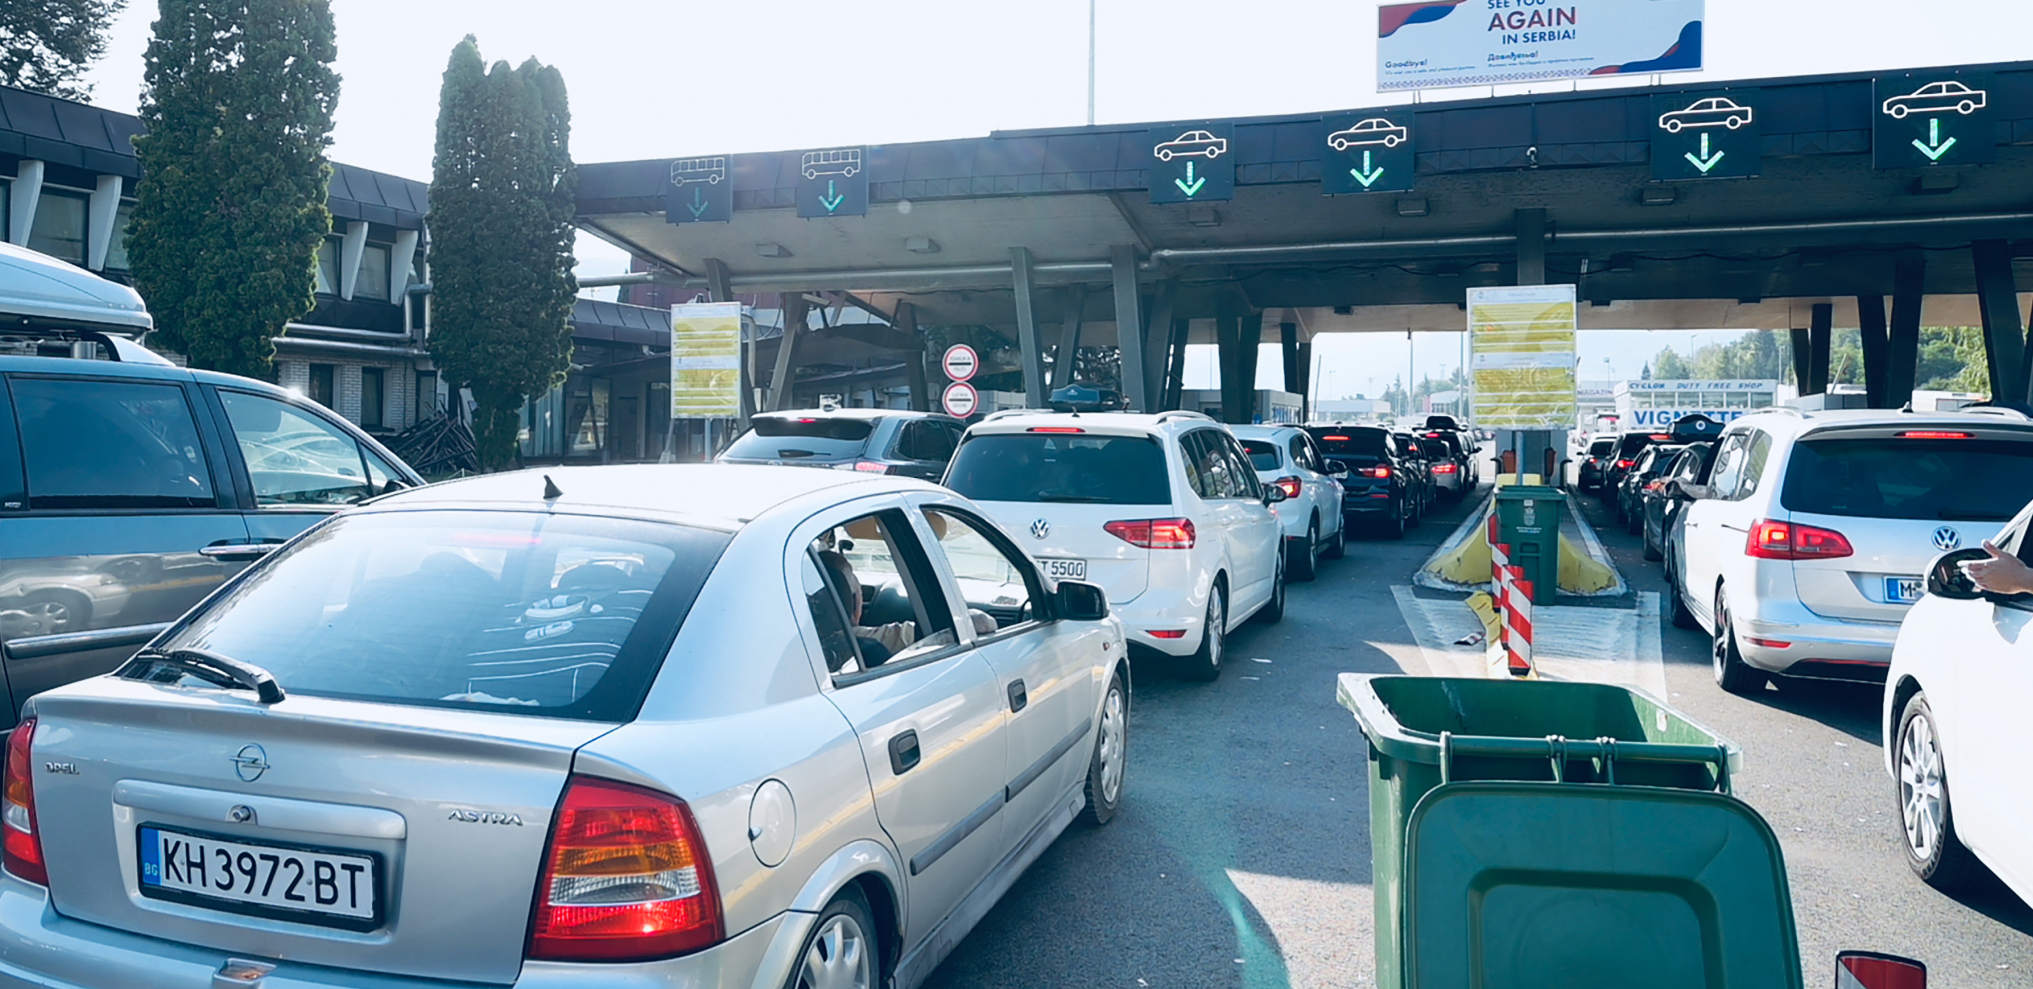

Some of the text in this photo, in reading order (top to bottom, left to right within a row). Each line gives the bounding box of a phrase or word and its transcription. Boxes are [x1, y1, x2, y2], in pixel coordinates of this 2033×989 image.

[1487, 0, 1510, 9] SEE
[1487, 6, 1576, 32] AGAIN
[1502, 29, 1576, 45] IN SERBIA!
[1385, 59, 1428, 68] Goodbye!
[1634, 410, 1743, 425] VIGNTTE
[1051, 560, 1083, 577] 5500
[45, 762, 80, 775] OPEL
[448, 808, 523, 826] ASTRA
[144, 862, 158, 876] BG
[214, 848, 306, 903] 3972
[314, 860, 365, 909] BT
